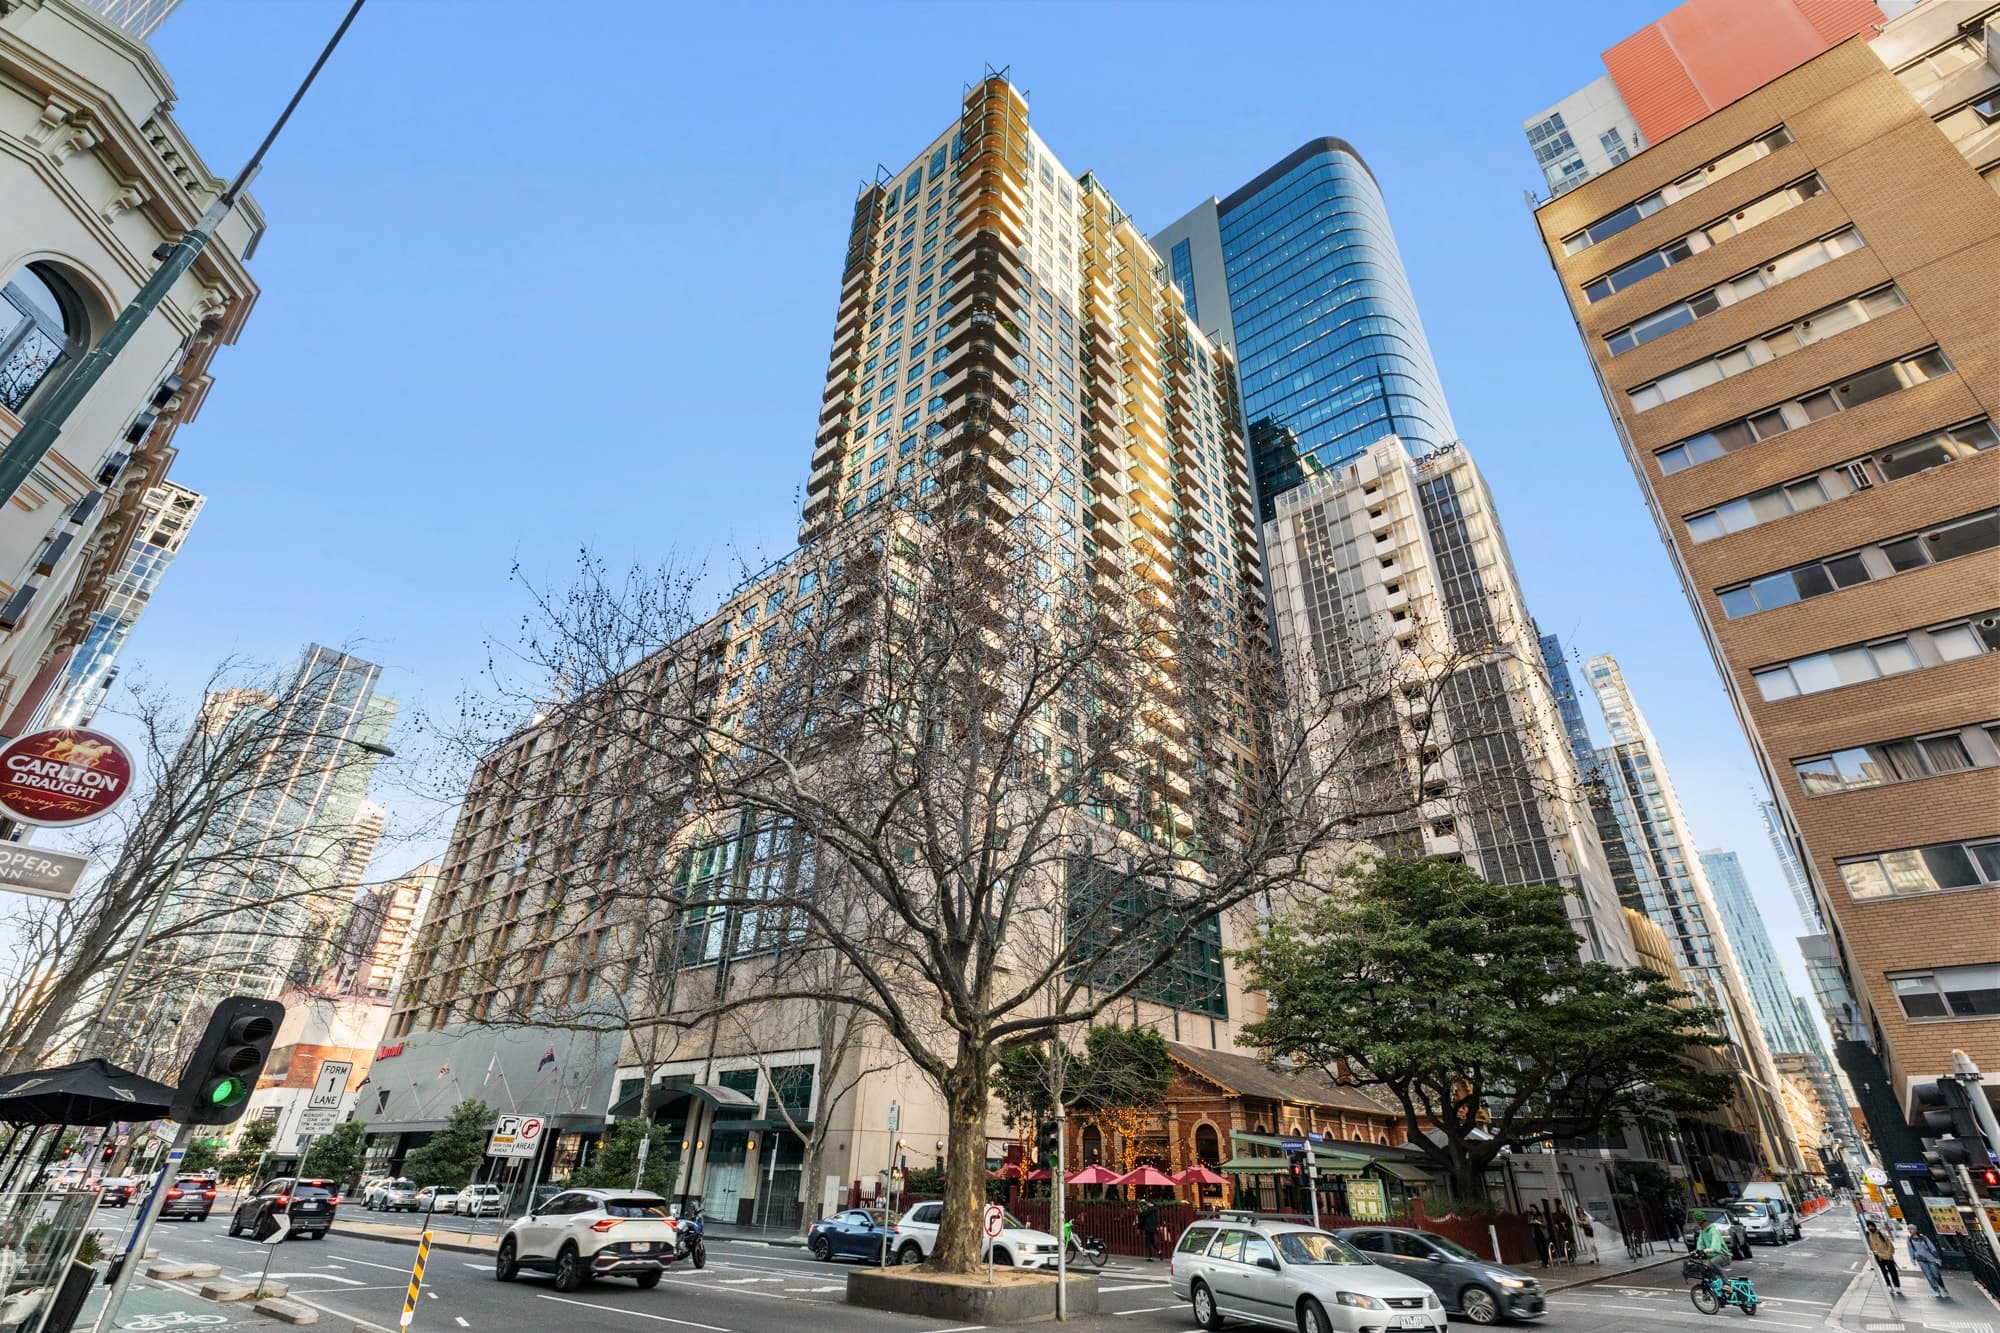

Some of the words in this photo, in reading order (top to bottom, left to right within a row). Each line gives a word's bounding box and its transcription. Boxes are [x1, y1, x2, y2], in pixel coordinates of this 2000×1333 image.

[1416, 441, 1456, 466] BRADY
[7, 755, 119, 792] CARLTON
[11, 772, 100, 799] DRAUGHT
[325, 1065, 348, 1075] FORM
[328, 1077, 336, 1093] 1
[314, 1095, 337, 1105] LANE
[516, 1142, 535, 1151] AHEAD
